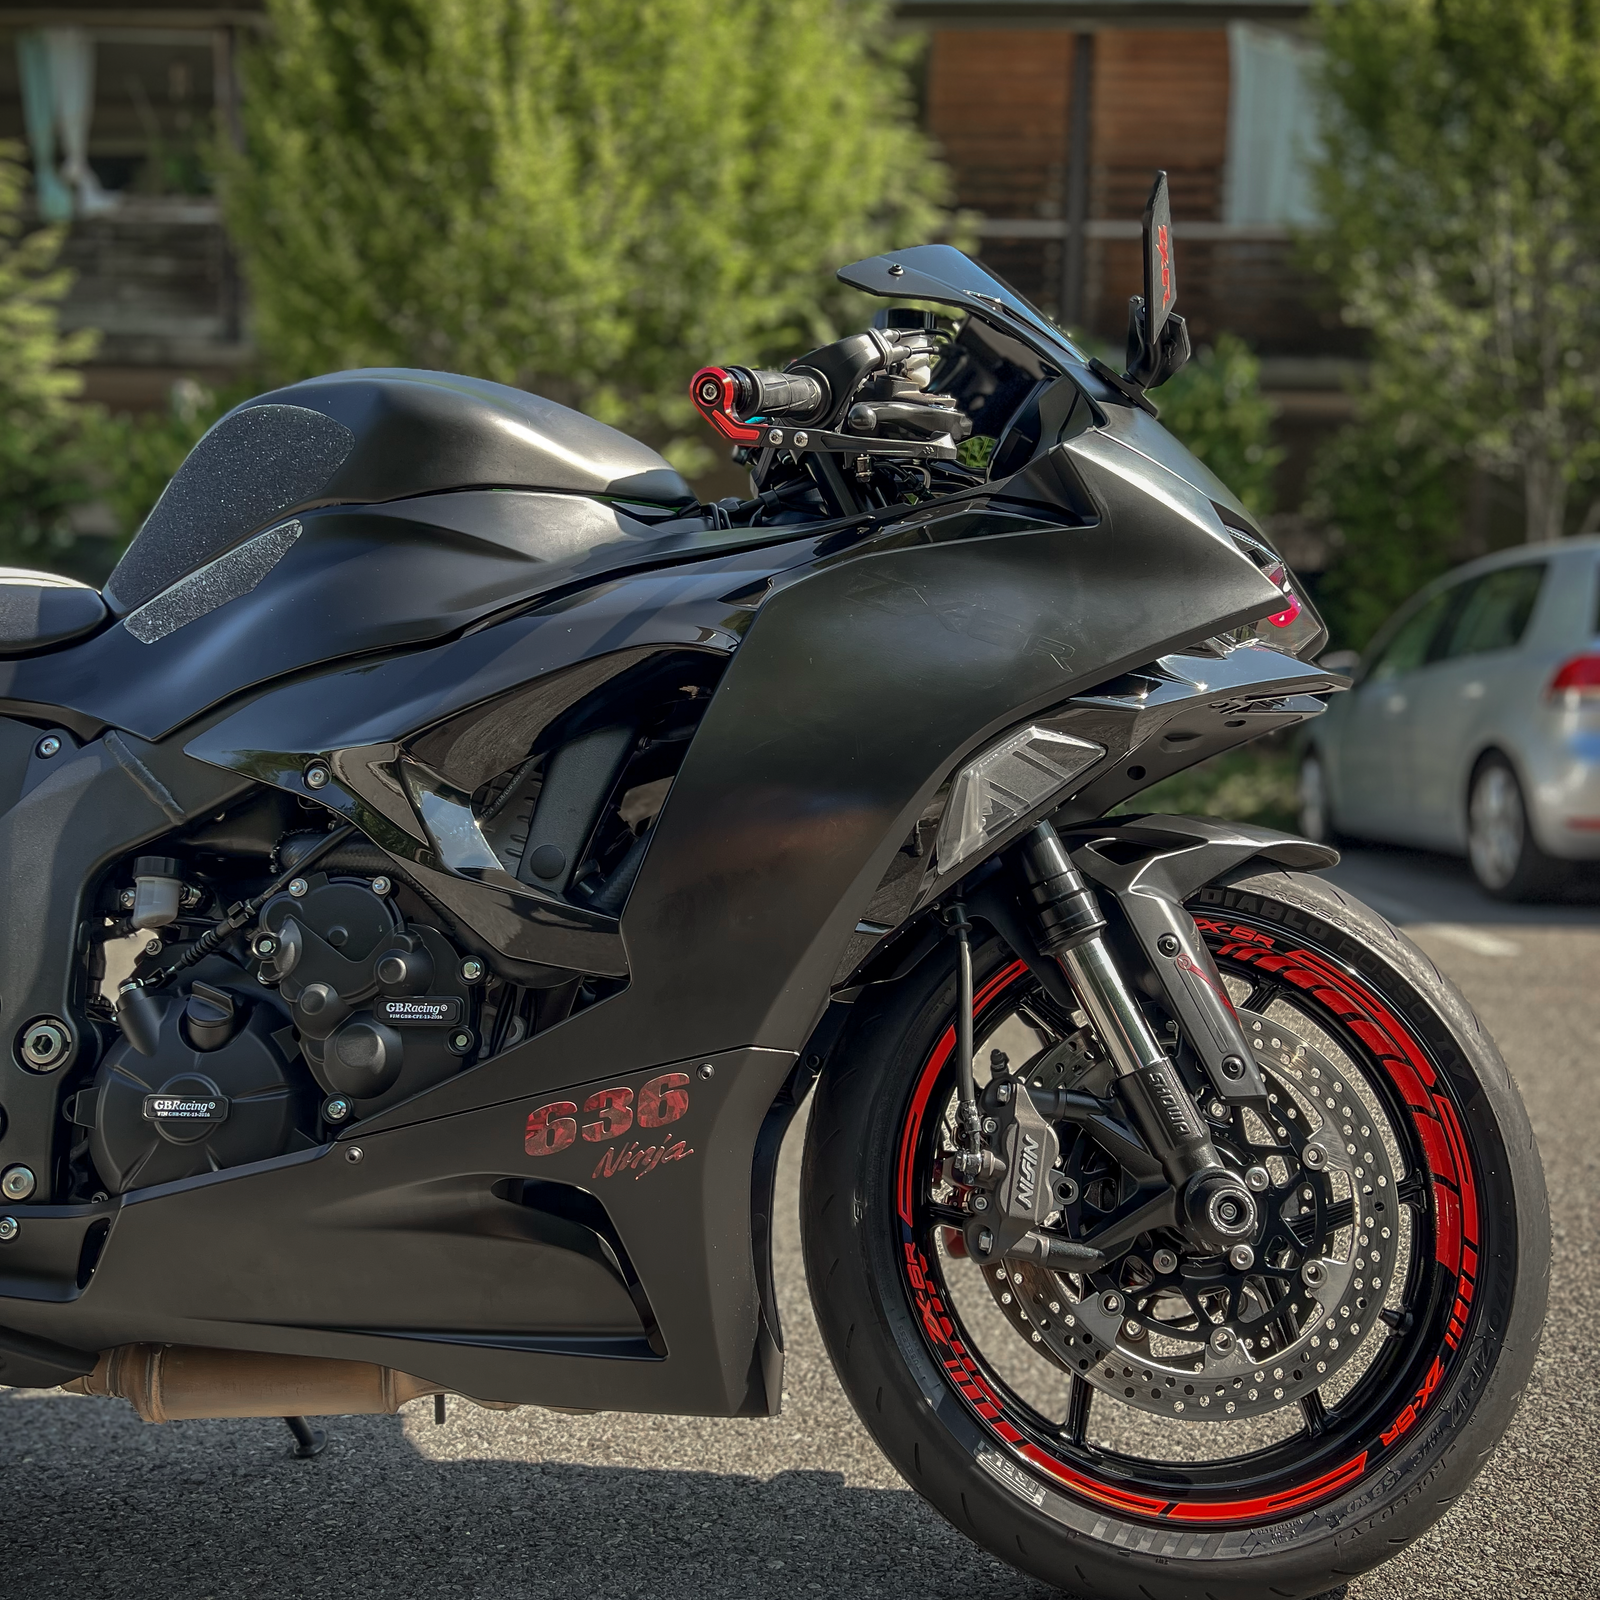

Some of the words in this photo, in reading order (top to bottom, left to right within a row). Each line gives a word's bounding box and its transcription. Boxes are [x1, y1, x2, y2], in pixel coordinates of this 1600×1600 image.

[1194, 918, 1275, 949] X-6R
[1199, 887, 1330, 942] DIABLO
[1336, 936, 1433, 1027] ROSSO
[525, 1073, 690, 1156] 636
[1149, 1073, 1190, 1137] SHOWA
[591, 1134, 694, 1180] Ninja
[904, 1241, 948, 1346] ZX-6R
[1379, 1355, 1445, 1447] ZX-6R
